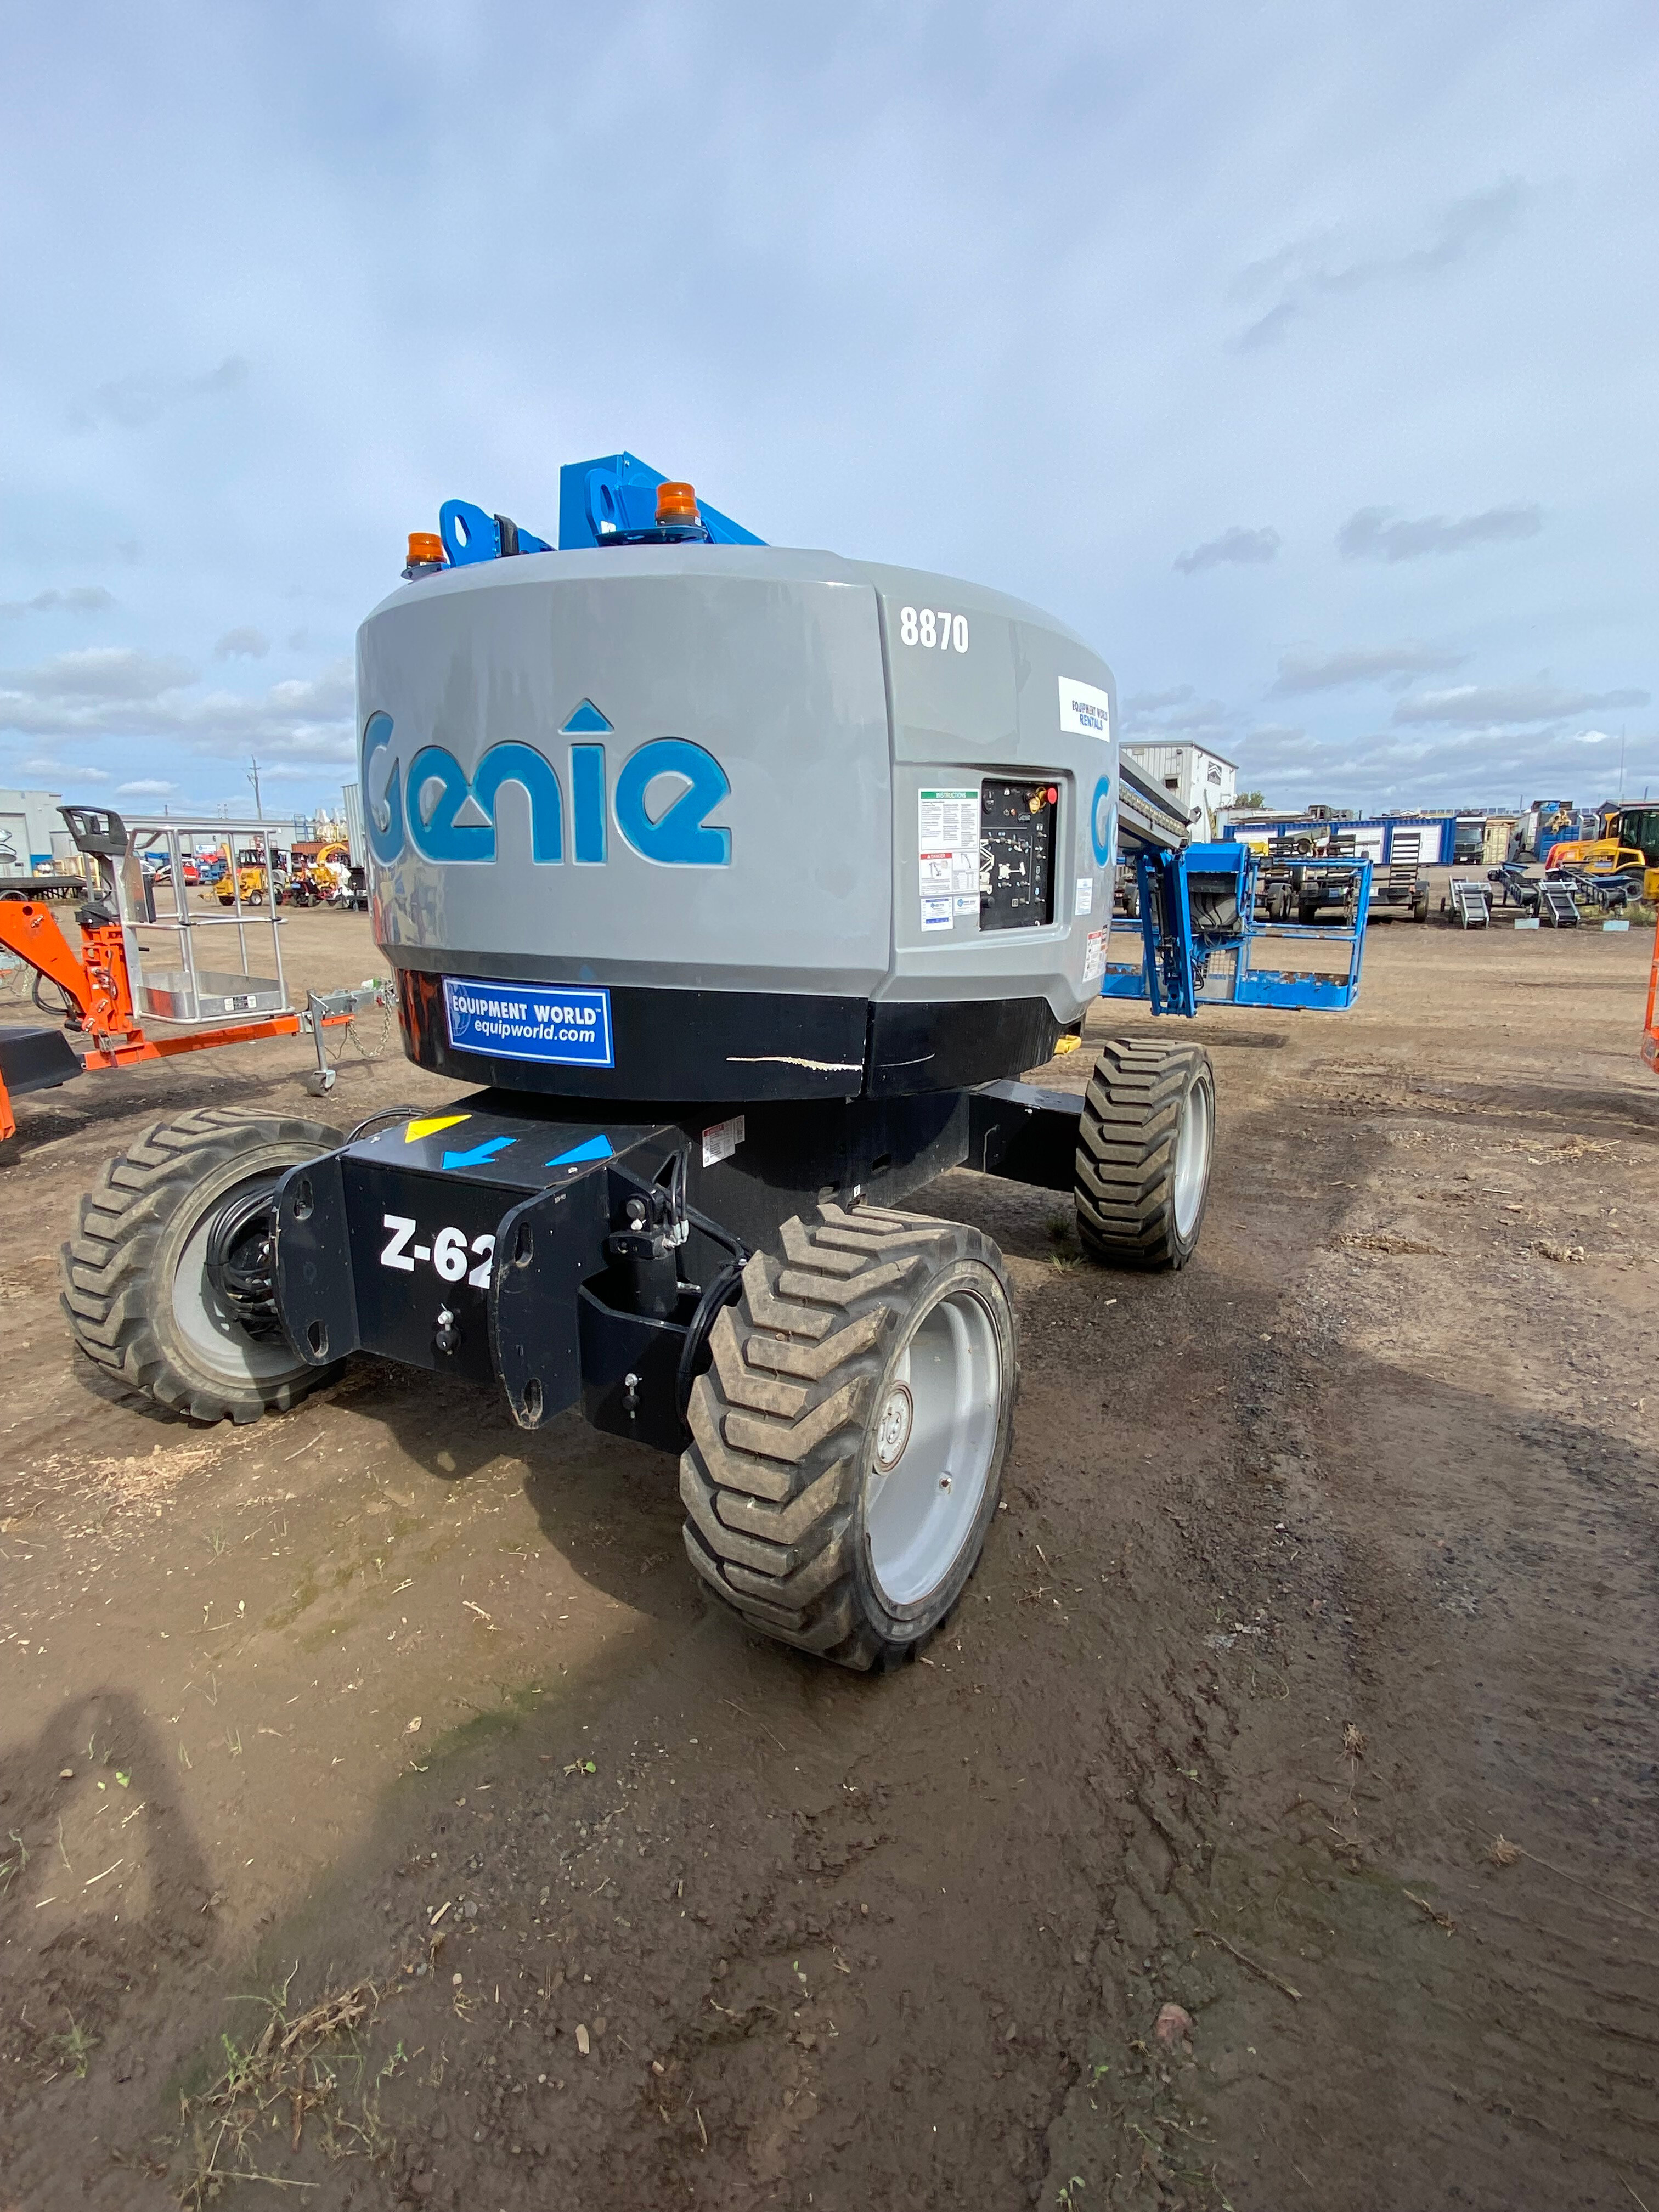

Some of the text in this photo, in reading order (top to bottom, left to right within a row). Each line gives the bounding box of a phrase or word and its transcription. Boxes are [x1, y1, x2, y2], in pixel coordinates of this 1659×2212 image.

[900, 606, 969, 653] 8870
[1080, 714, 1103, 731] RENTALS
[363, 697, 732, 869] Genie
[452, 995, 527, 1020] EQUIPMENT
[474, 1019, 595, 1043] equipworld.com
[381, 1214, 496, 1290] Z-62
